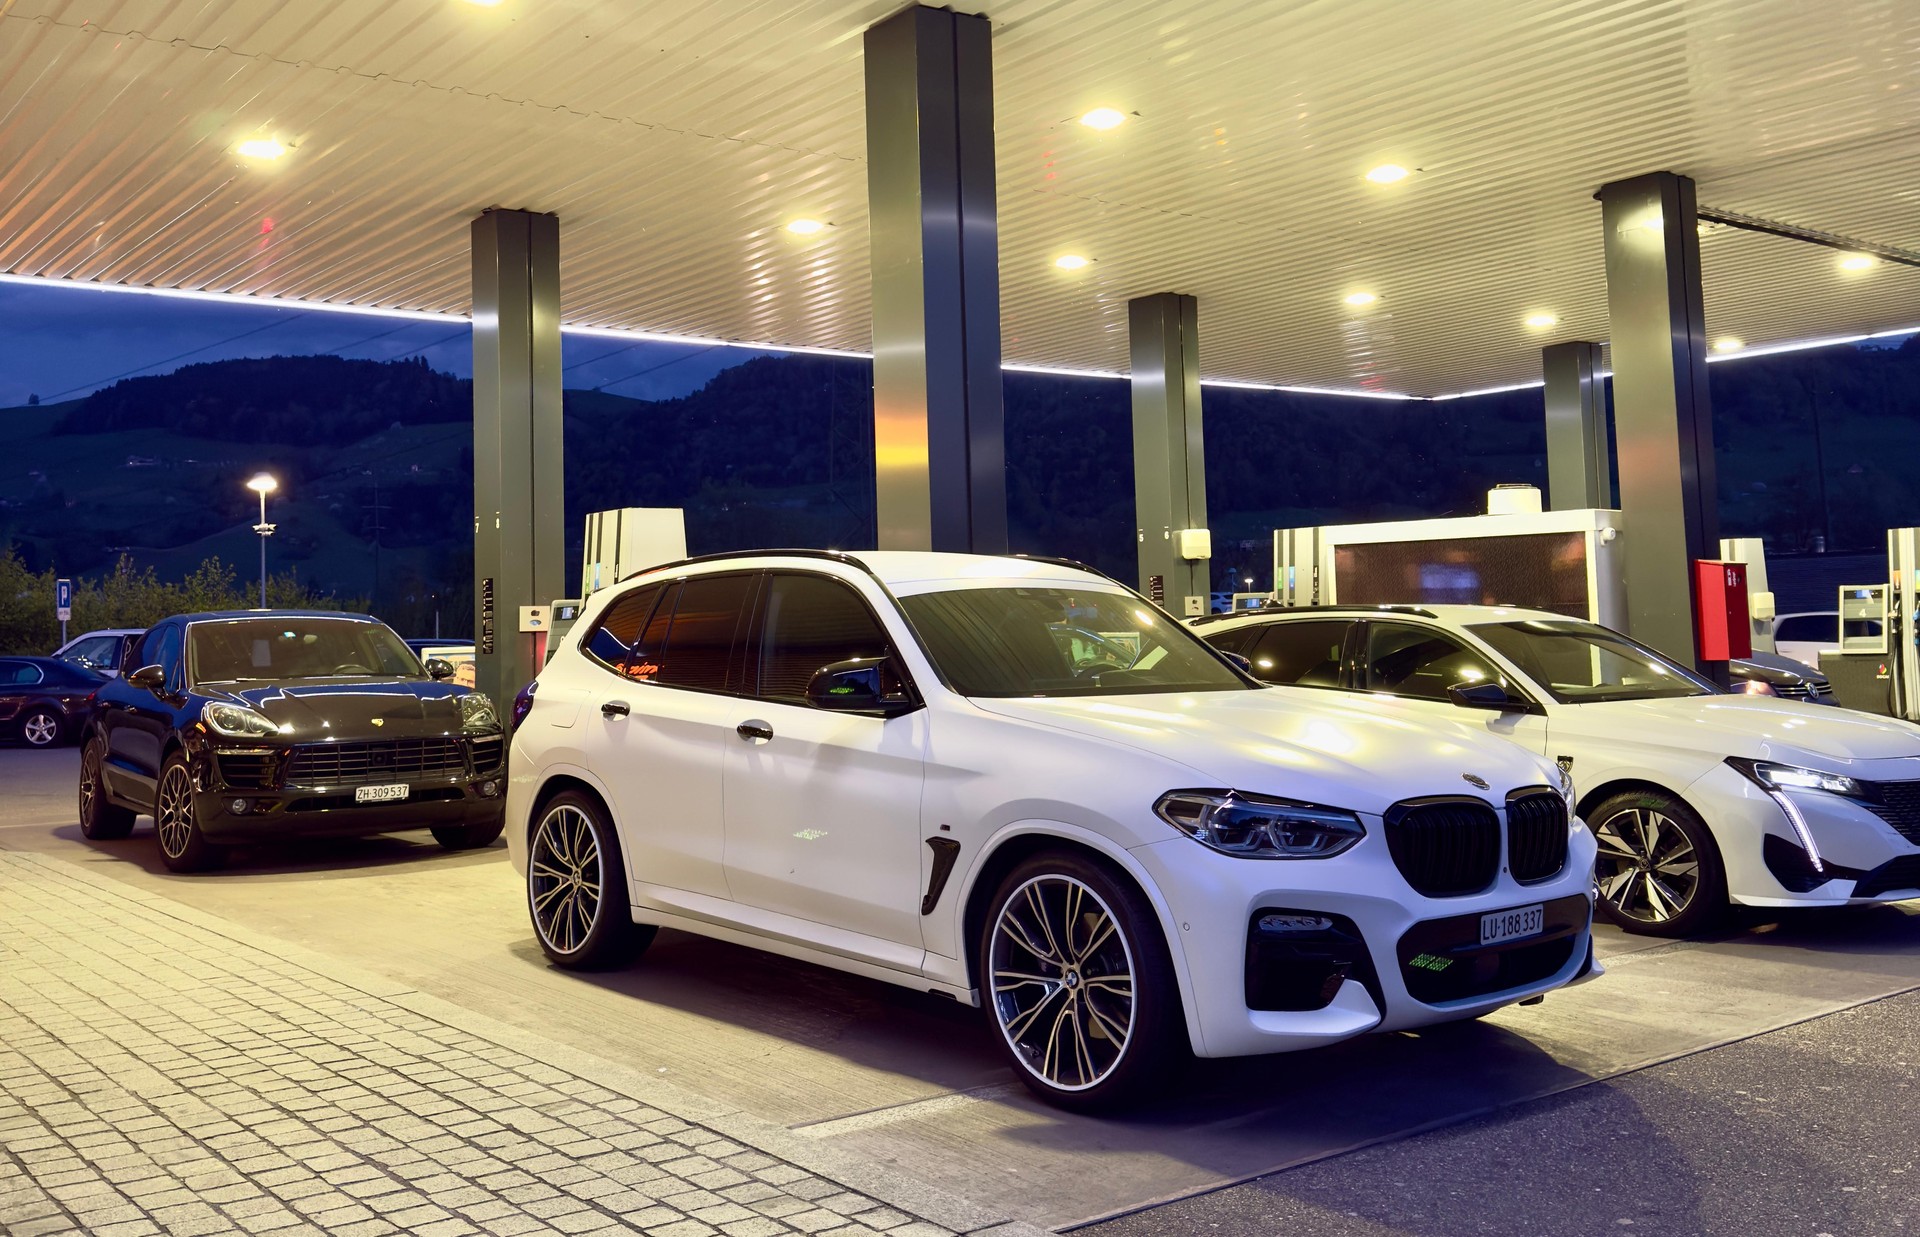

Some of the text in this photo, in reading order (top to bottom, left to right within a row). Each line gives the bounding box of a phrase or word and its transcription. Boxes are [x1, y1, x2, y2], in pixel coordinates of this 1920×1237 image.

[475, 523, 480, 533] 7
[1139, 533, 1144, 542] 5
[1164, 531, 1170, 540] 6
[61, 585, 68, 605] P
[1859, 608, 1867, 617] 4
